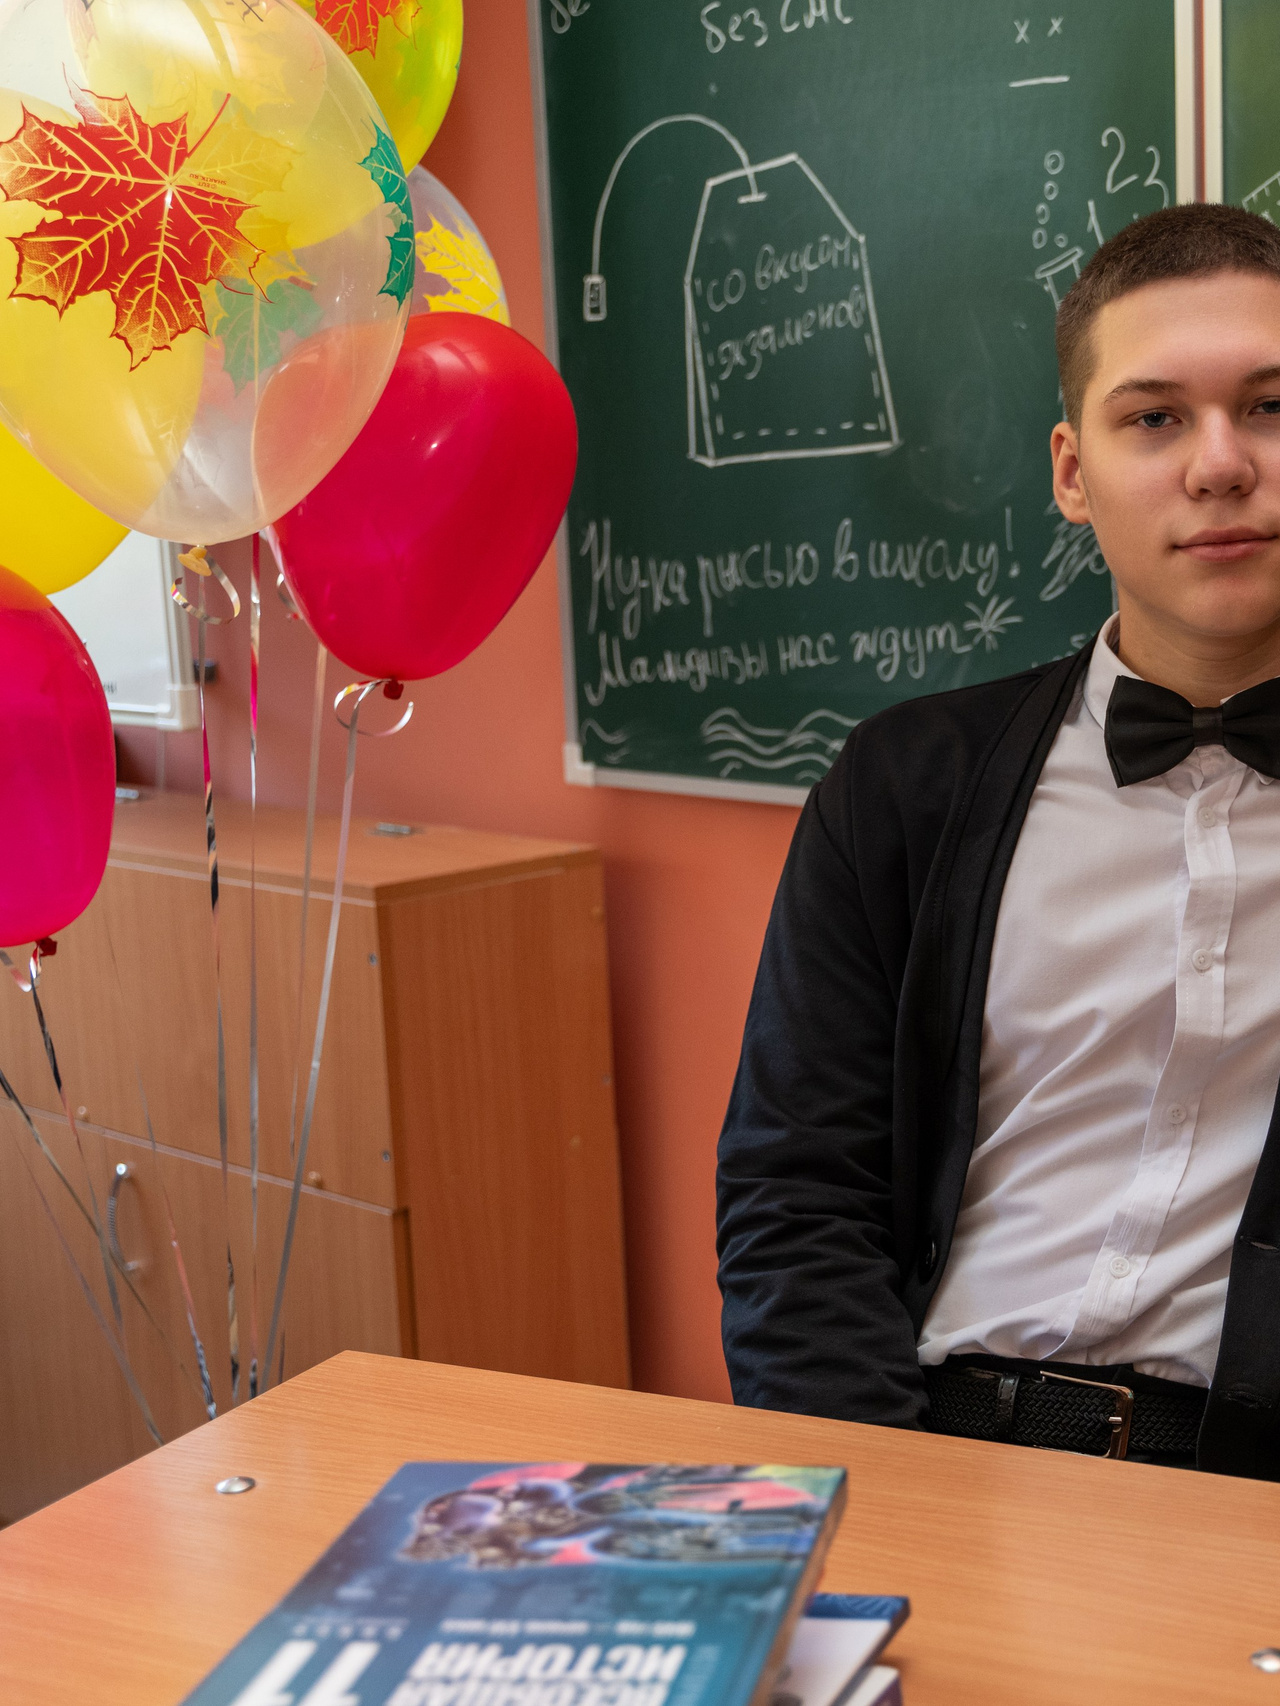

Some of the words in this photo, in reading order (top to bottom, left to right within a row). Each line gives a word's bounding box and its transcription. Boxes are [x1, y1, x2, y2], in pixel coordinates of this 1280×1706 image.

[700, 0, 770, 54] без
[706, 267, 747, 312] со
[754, 233, 853, 294] вкусом
[832, 517, 860, 582] в
[777, 632, 840, 676] нас
[408, 1641, 688, 1680] ИСТОРИЯ
